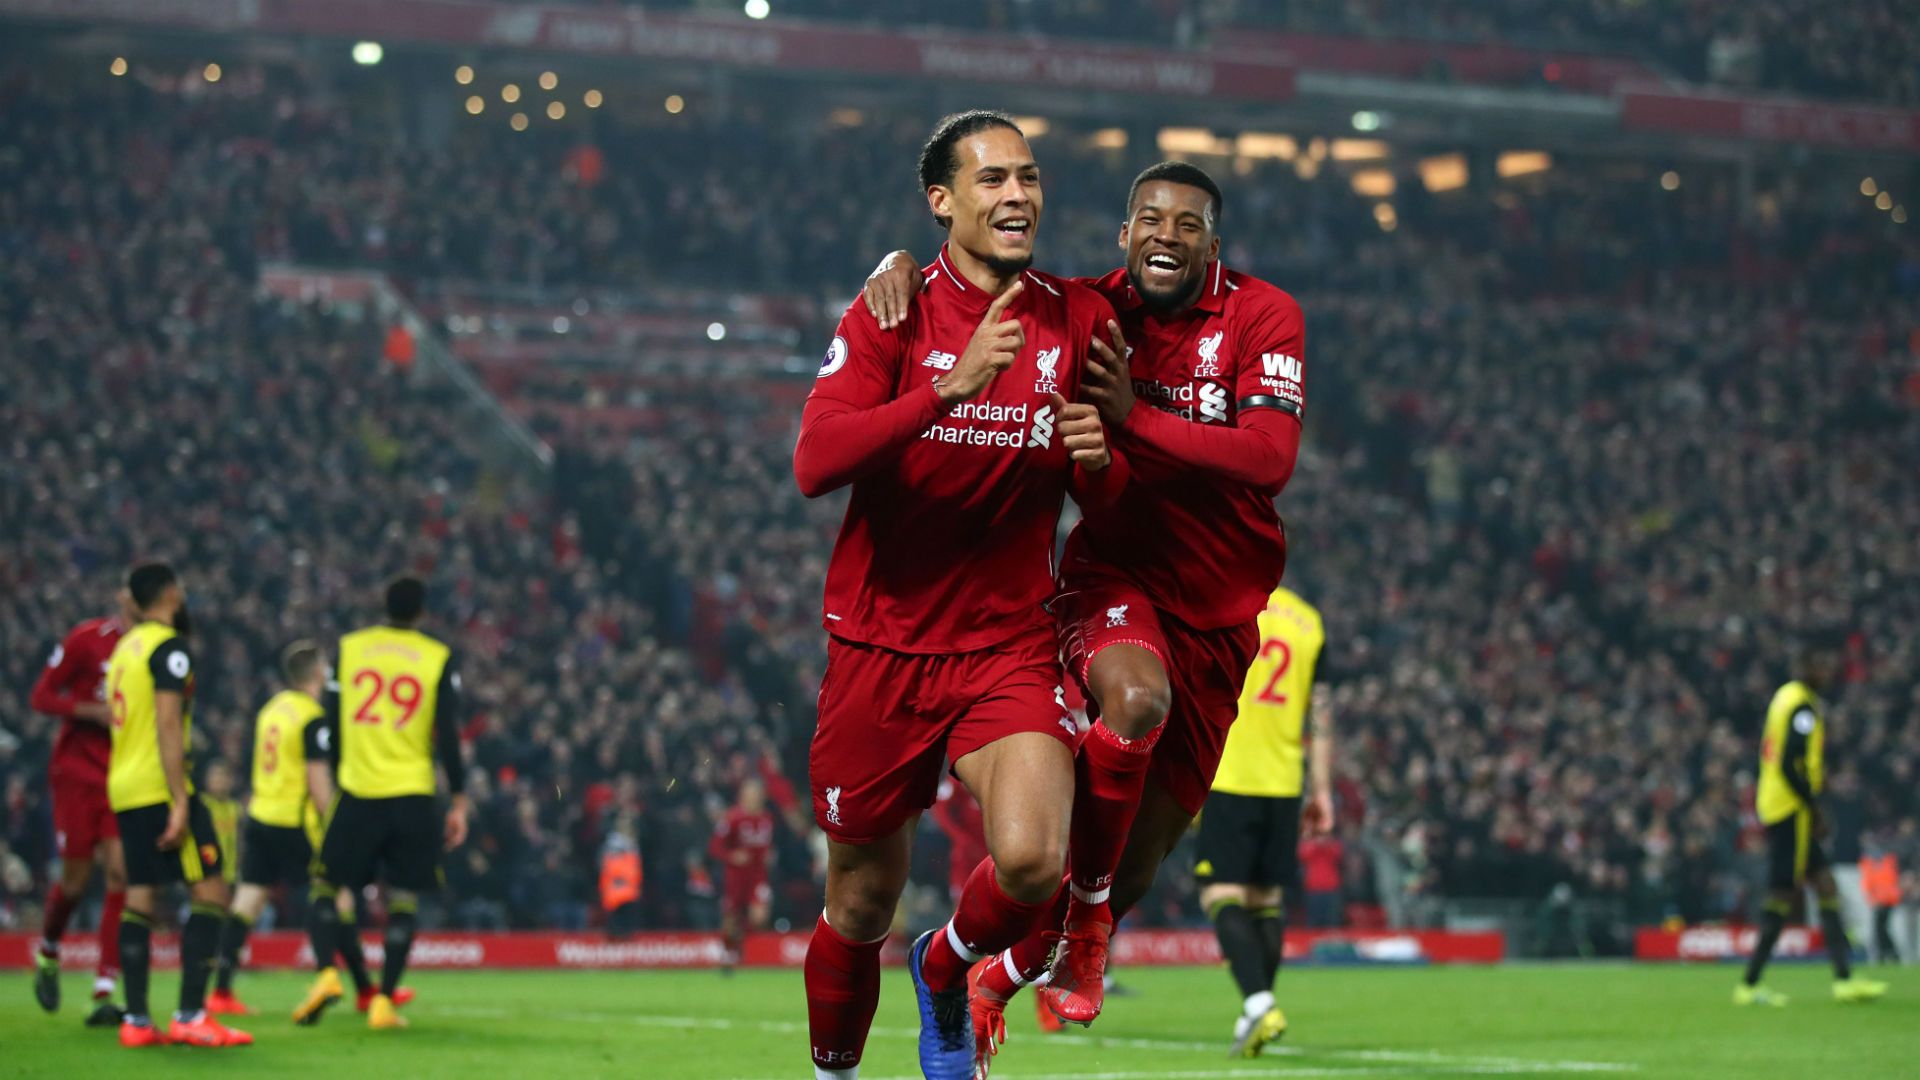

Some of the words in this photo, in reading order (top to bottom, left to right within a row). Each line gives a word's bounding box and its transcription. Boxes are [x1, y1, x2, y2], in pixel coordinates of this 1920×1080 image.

[1262, 353, 1302, 383] WU
[1134, 380, 1193, 401] ndard
[1260, 377, 1301, 397] Western
[1274, 388, 1303, 406] Union
[949, 400, 1027, 423] andard
[920, 424, 1024, 448] hartered
[1259, 638, 1292, 704] 2
[353, 669, 424, 730] 29
